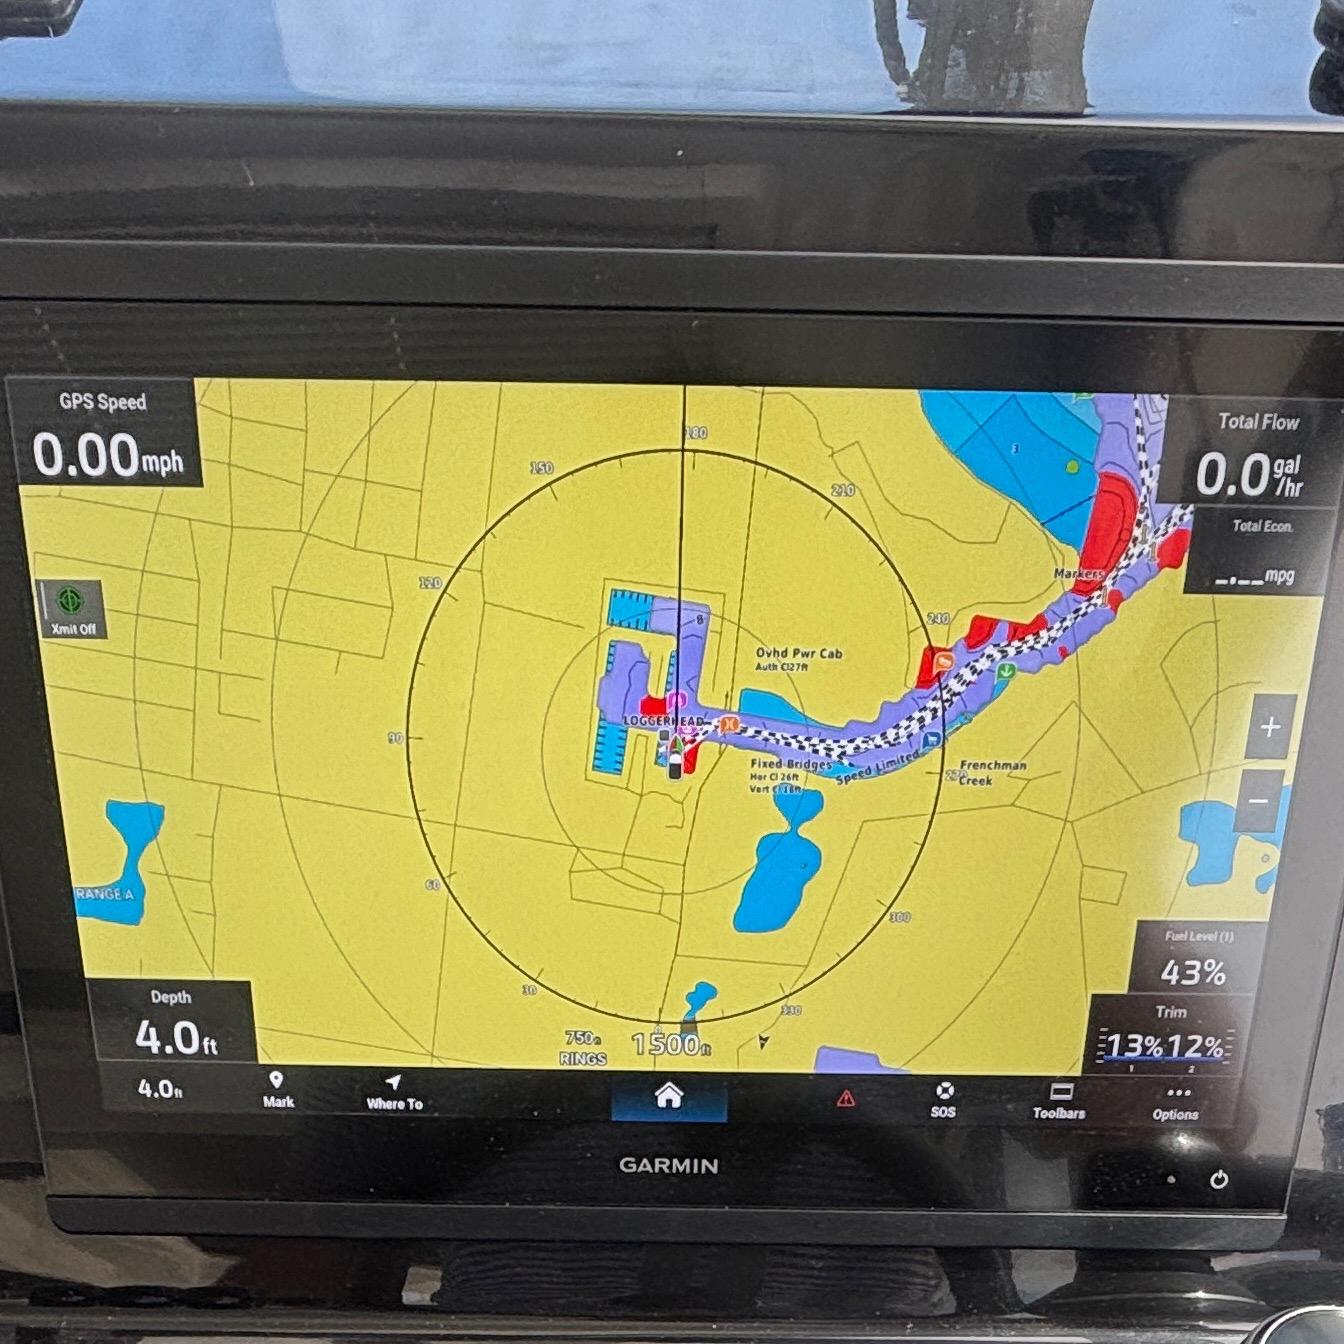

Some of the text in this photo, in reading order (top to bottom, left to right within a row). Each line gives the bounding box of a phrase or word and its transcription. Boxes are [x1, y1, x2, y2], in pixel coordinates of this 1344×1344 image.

[59, 392, 147, 413] GPS Speed
[1218, 413, 1301, 430] Total Flow
[685, 426, 708, 440] 180
[529, 461, 554, 475] 150
[1273, 454, 1302, 476] gal
[1196, 451, 1271, 496] 0.0
[831, 484, 855, 497] 210
[1274, 476, 1304, 498] /hr
[1233, 519, 1294, 533] Total Econ.
[1054, 567, 1106, 579] Markers
[419, 576, 442, 590] 120
[927, 612, 950, 626] 240
[51, 623, 97, 636] Xmit Off
[756, 647, 843, 660] Ovhd Pwr Cab
[755, 663, 778, 672] Auth
[387, 731, 404, 745] 90
[750, 758, 832, 773] Fixed Bridges
[835, 750, 921, 786] Speed Limited
[959, 760, 1027, 771] Frenchman
[958, 776, 993, 786] Creek
[1165, 930, 1187, 942] Fuel
[1189, 930, 1219, 942] Level
[1160, 958, 1227, 986] 43%
[150, 990, 192, 1006] Depth
[1156, 1005, 1188, 1019] Trim
[1107, 1033, 1225, 1058] 13% 12%
[560, 1051, 608, 1067] RINGS
[263, 1096, 295, 1109] Mark
[366, 1097, 423, 1111] Where To
[930, 1106, 957, 1119] SOS
[1033, 1107, 1086, 1121] Toolbars
[1152, 1108, 1200, 1122] Options
[619, 1157, 719, 1175] GARMIN
